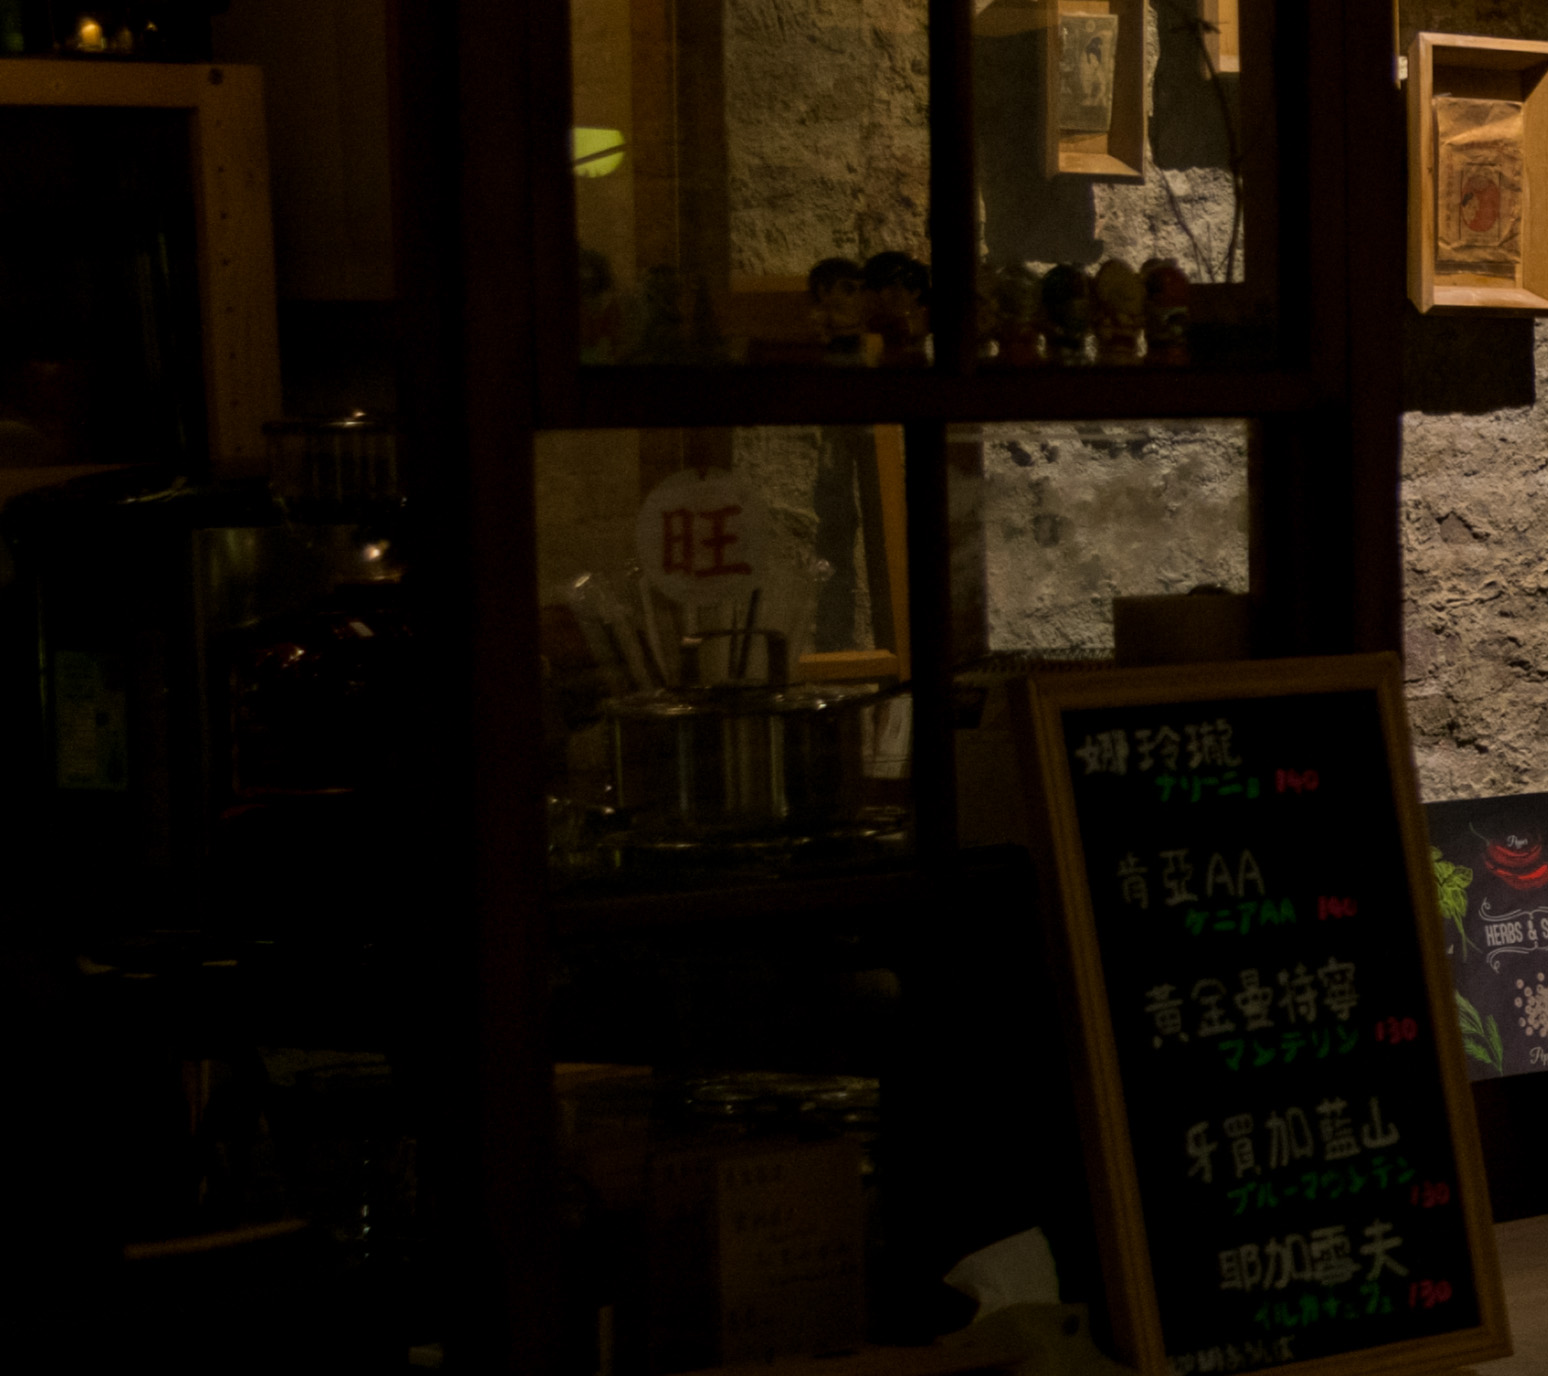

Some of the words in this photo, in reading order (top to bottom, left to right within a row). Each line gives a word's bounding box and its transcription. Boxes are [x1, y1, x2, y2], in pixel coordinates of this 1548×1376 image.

[660, 504, 753, 579] 旺
[1484, 922, 1524, 949] HERBS
[1527, 918, 1538, 942] &
[1183, 1094, 1401, 1185] 牙買加藍山
